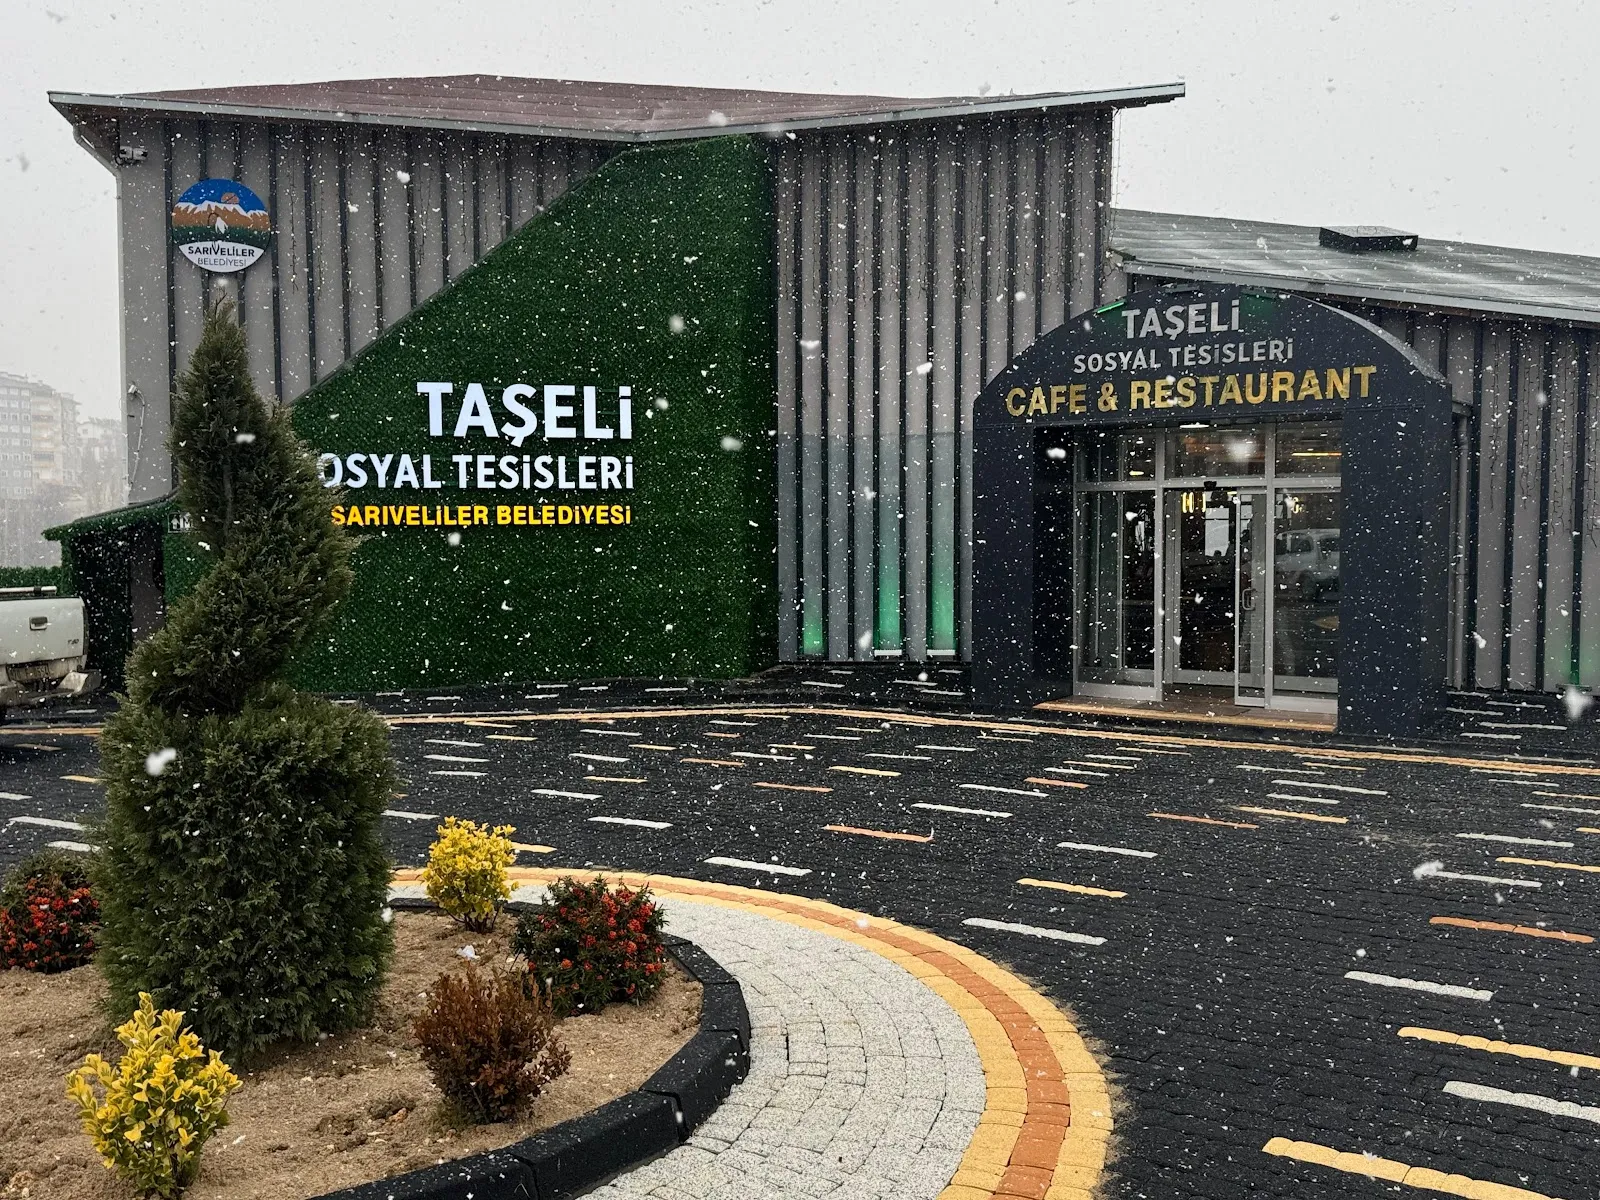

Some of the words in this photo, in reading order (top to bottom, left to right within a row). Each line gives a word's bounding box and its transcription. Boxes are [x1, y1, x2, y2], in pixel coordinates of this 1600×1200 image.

[1073, 346, 1161, 374] SOSYAL
[1006, 384, 1087, 417] CAFE
[1097, 382, 1118, 412] &
[1130, 365, 1378, 410] RESTAURANT
[316, 453, 442, 489] OSYAL
